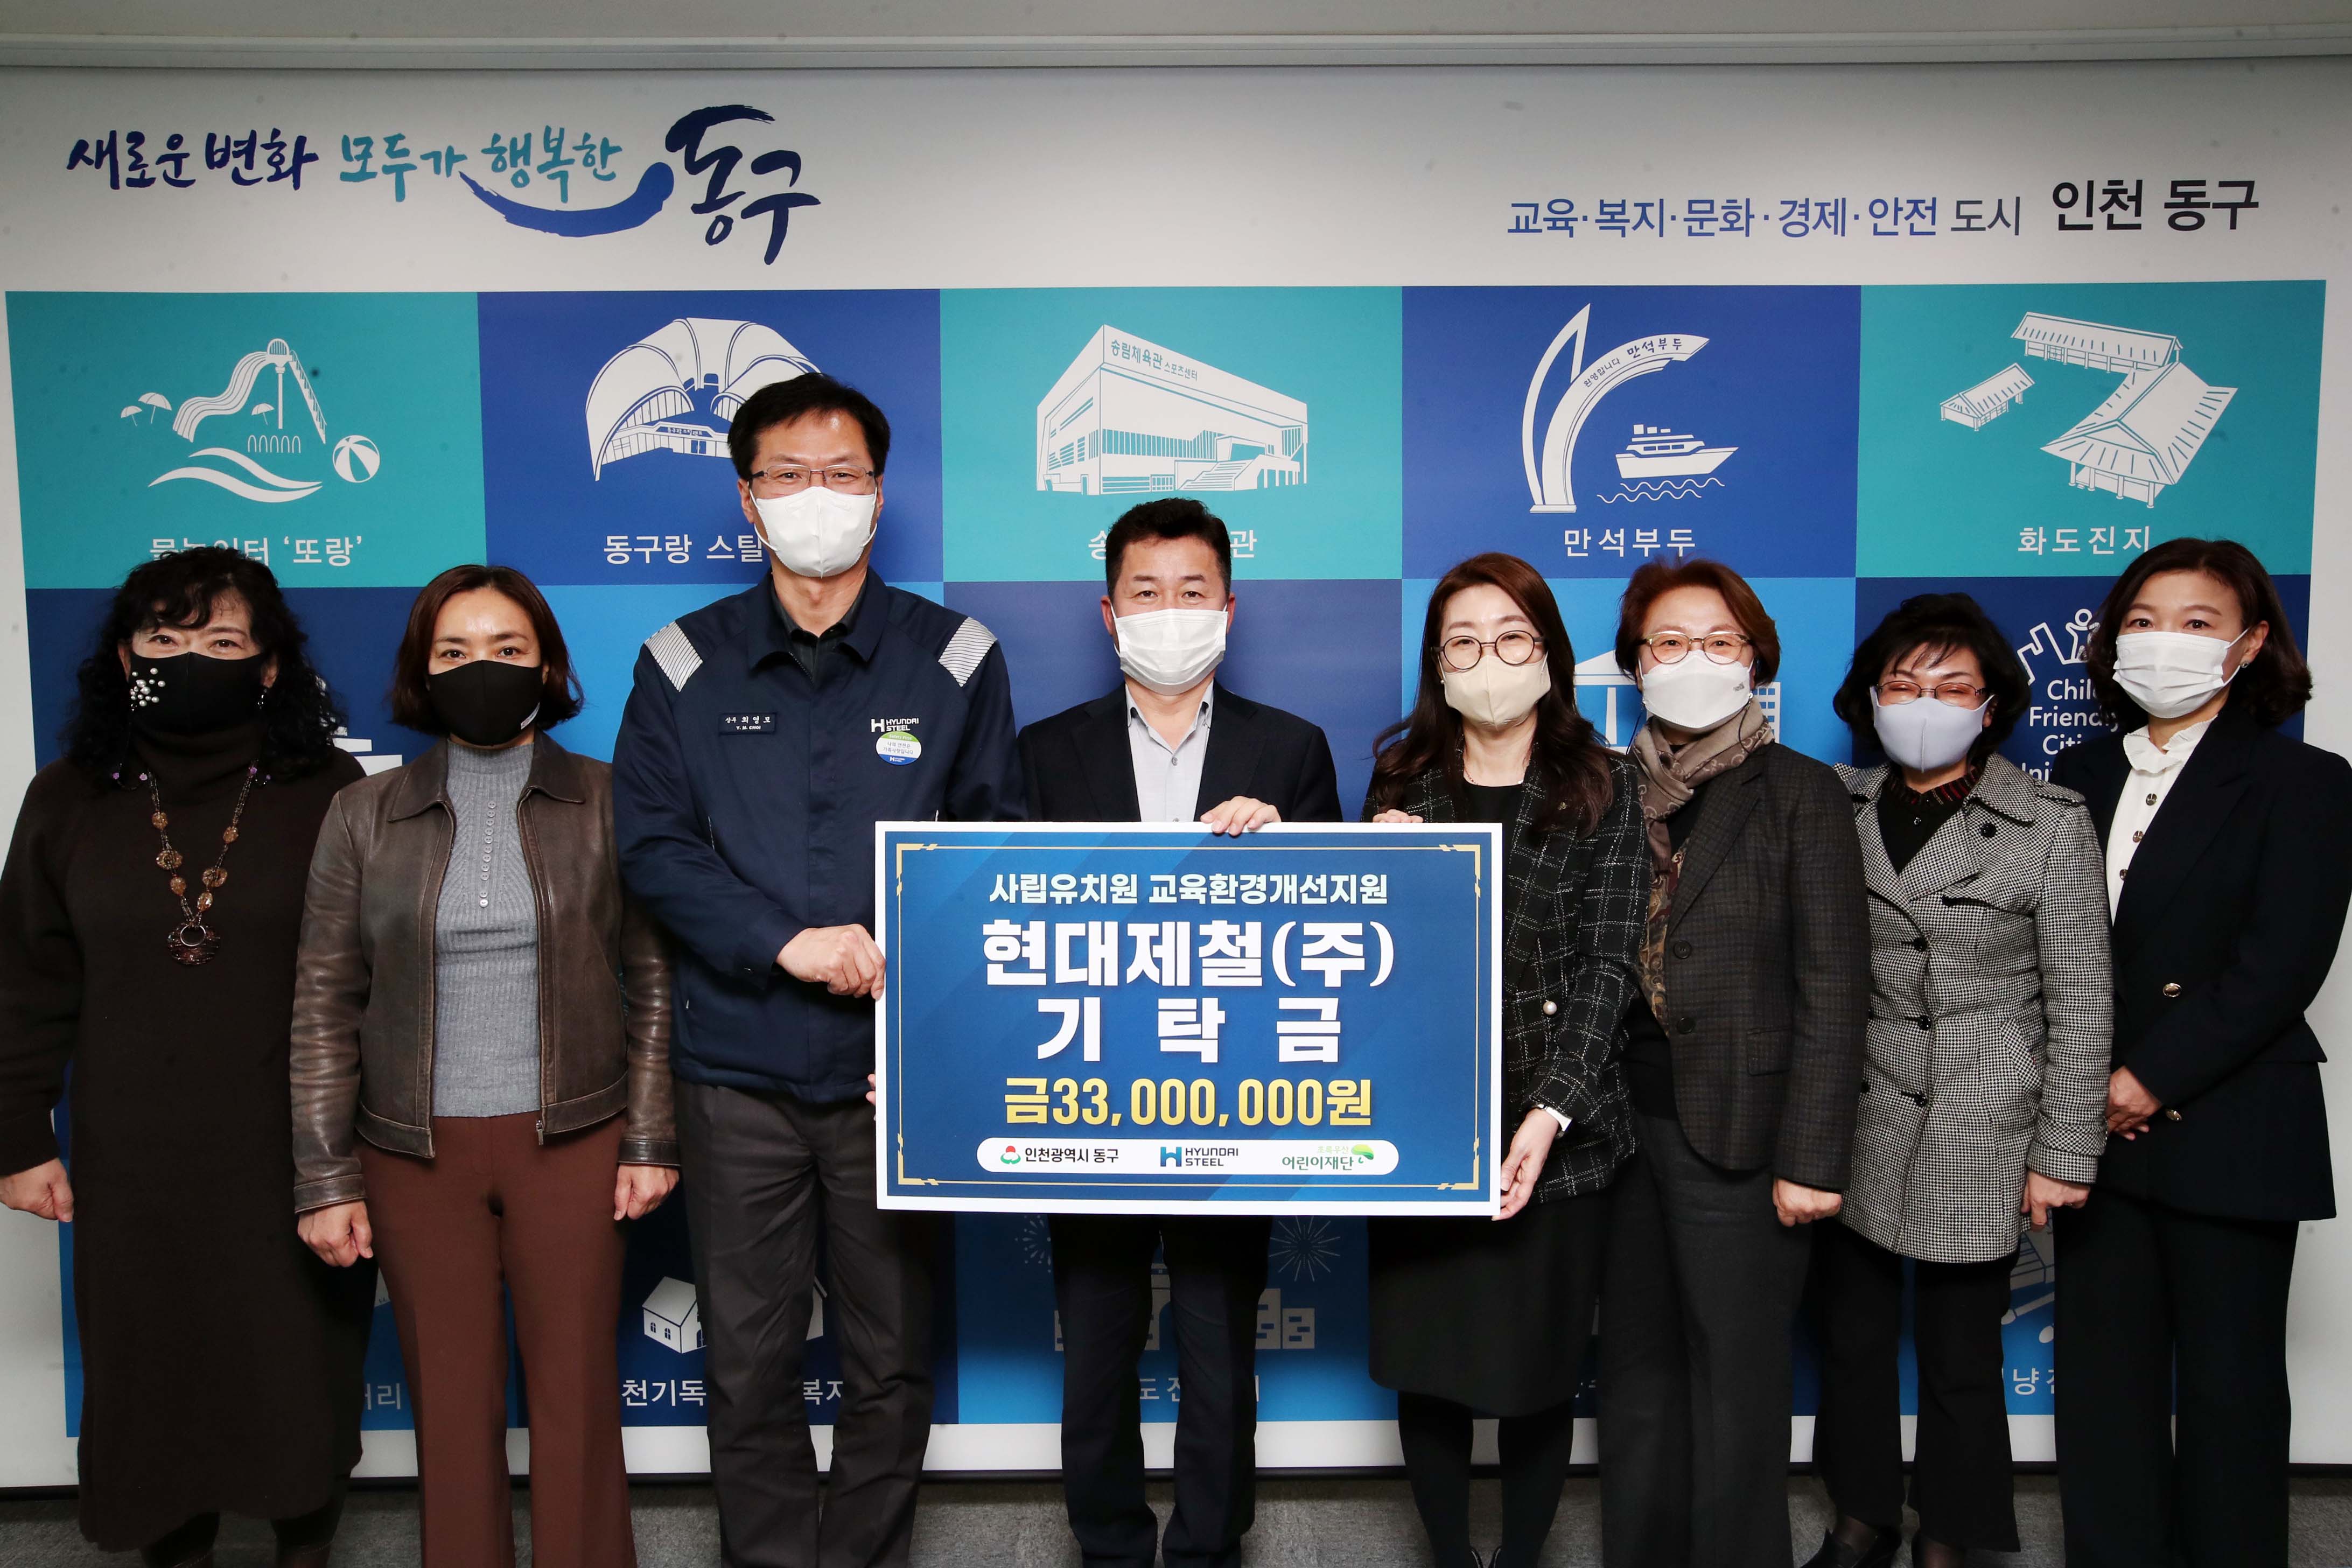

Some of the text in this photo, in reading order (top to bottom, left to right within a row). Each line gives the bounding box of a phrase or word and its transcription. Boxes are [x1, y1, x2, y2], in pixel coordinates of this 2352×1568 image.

[66, 104, 821, 265] 새로운 변화 모두가 행복한 동구
[1950, 196, 2021, 236] 도시
[2052, 179, 2143, 231] 인천
[2164, 179, 2259, 232] 동구
[1111, 339, 1163, 370] 송림체육관
[1627, 338, 1682, 359] 만석부두
[604, 534, 692, 564] 동구랑
[1564, 528, 1695, 557] 만석부두
[2018, 526, 2150, 555] 화도진지
[2047, 678, 2096, 700] Chil
[989, 873, 1388, 905] 사립유치원 교육환경개선지원
[982, 919, 1395, 988] 현대제철(주)
[1005, 1077, 1372, 1128] 금33,000,000원
[1025, 1147, 1119, 1163] 인천광역시 동구
[1185, 1147, 1239, 1157] HYUNDAI
[1185, 1158, 1224, 1166] STEEL
[1282, 1156, 1354, 1171] 어린이재단
